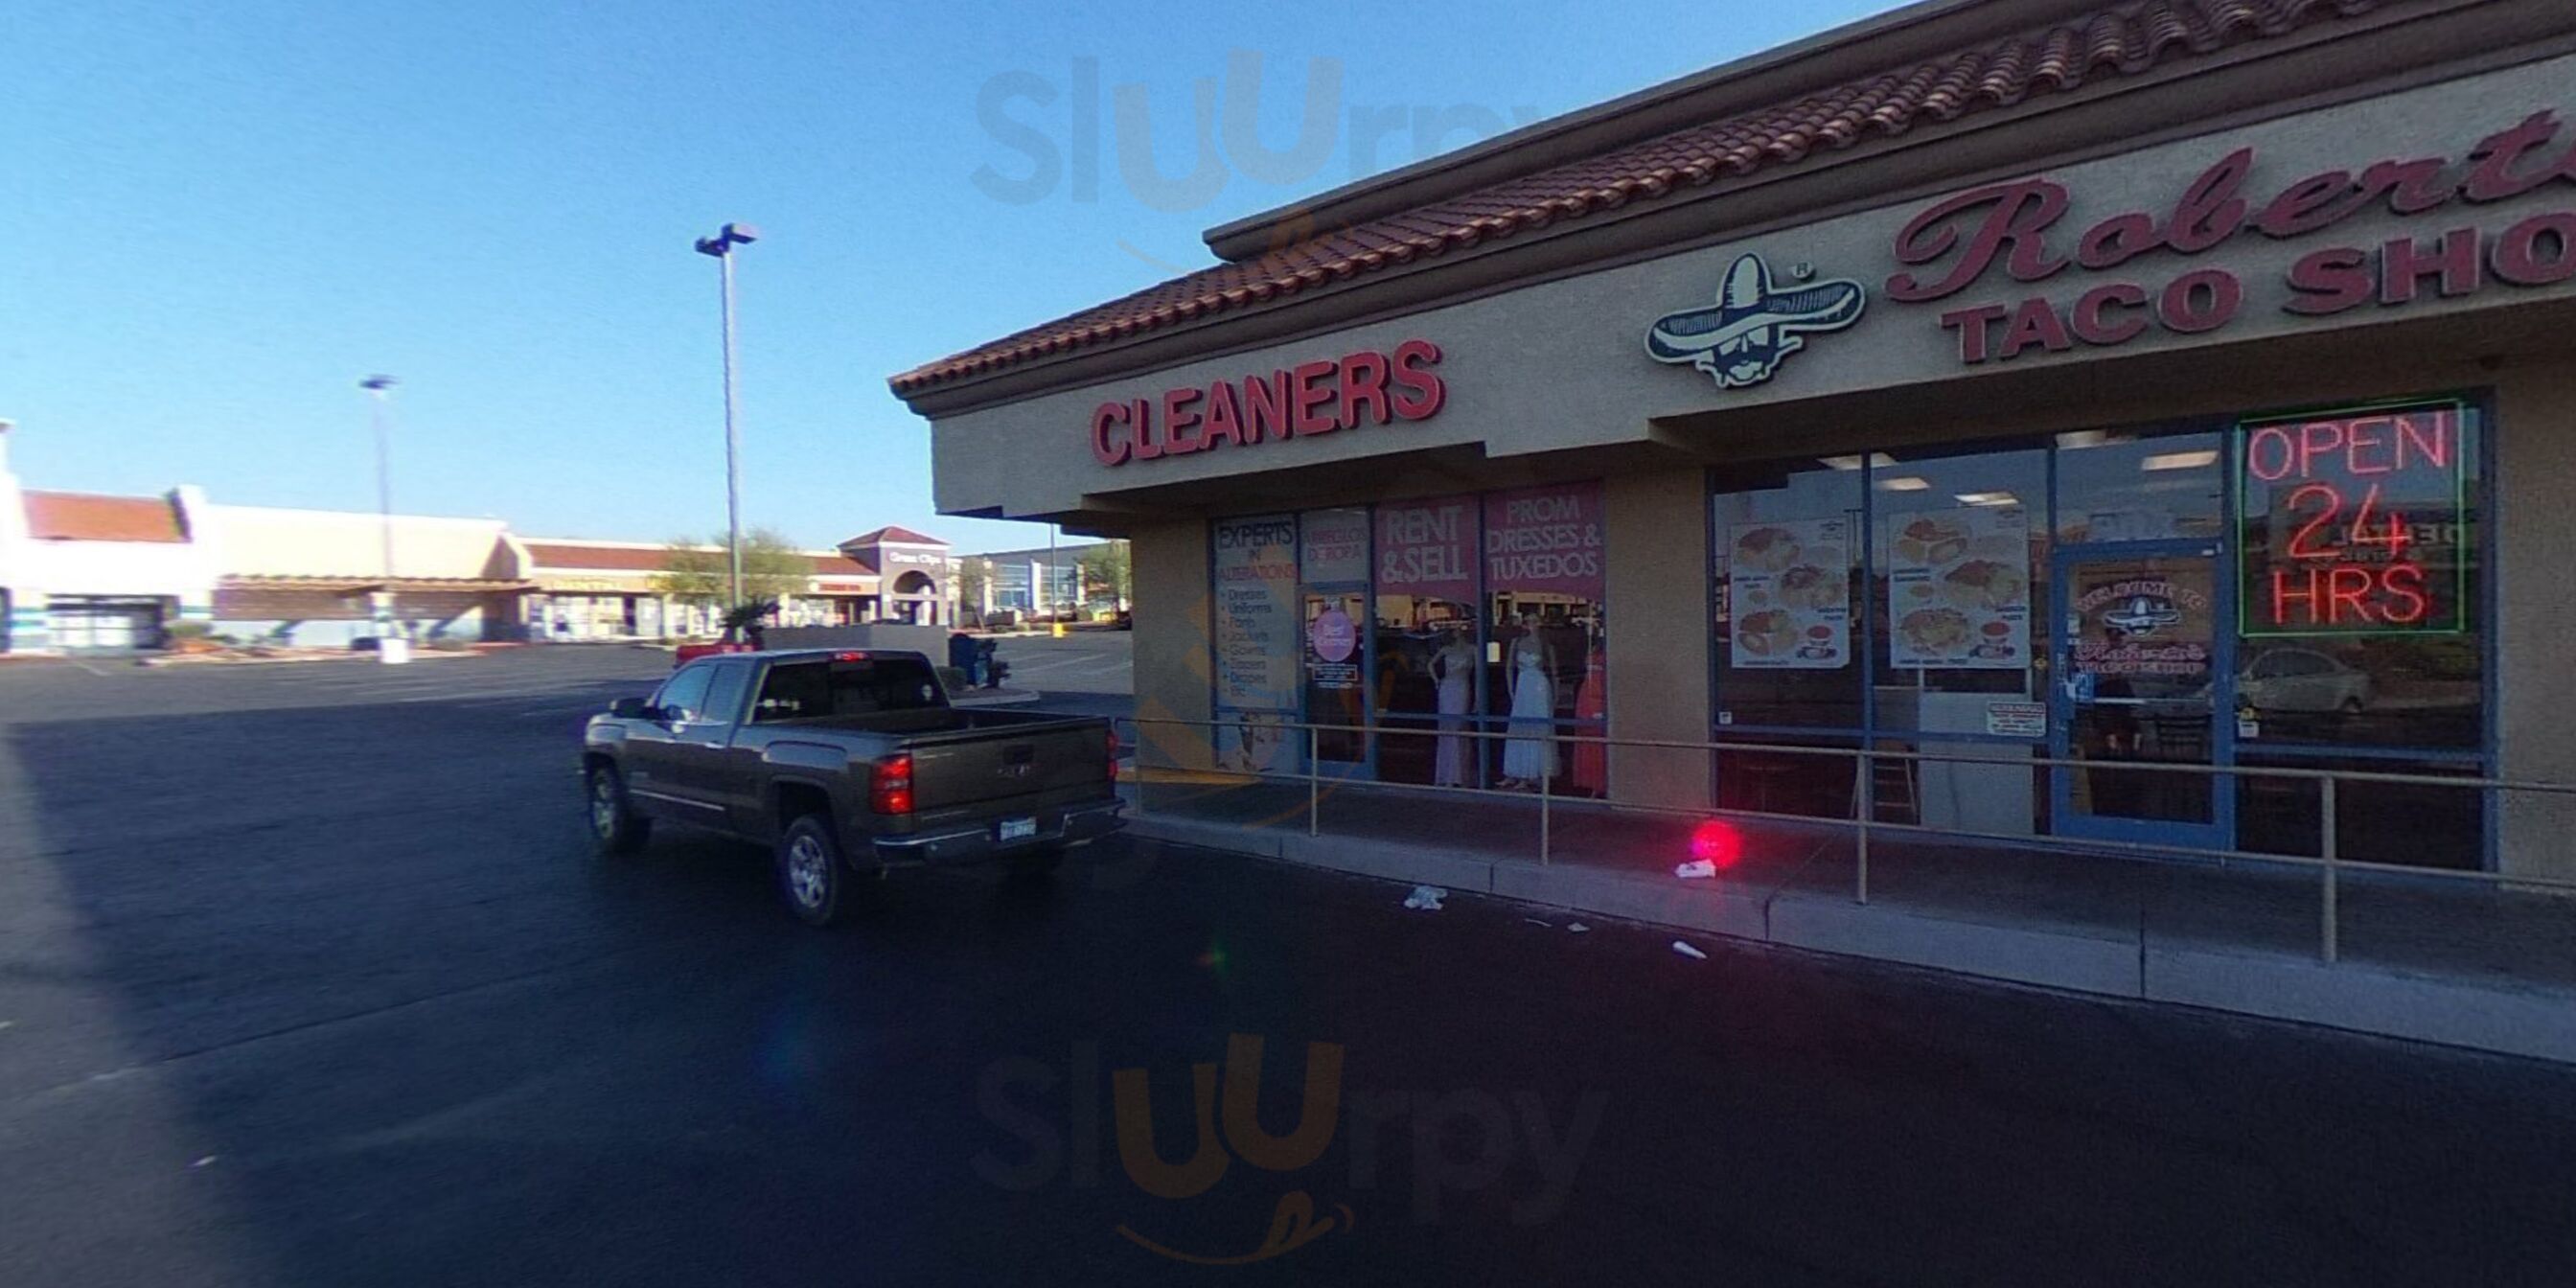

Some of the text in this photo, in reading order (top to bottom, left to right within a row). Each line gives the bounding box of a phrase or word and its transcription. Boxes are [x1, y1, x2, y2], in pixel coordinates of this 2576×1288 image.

[1884, 108, 2576, 302] Robert
[1939, 267, 2243, 364] TACO
[1090, 339, 1446, 467] CLEANERS
[2248, 412, 2448, 481] OPEN
[1387, 505, 1463, 545] RENT
[1506, 495, 1581, 523] PROM
[2288, 481, 2414, 559] 24
[1218, 520, 1293, 548] EXPERTS
[1487, 523, 1602, 554] DRESSES &
[1490, 551, 1598, 581] TUXEDOS
[1229, 588, 1267, 600] Dresses
[1229, 603, 1272, 614] Uniforms
[2274, 563, 2426, 625] HRS
